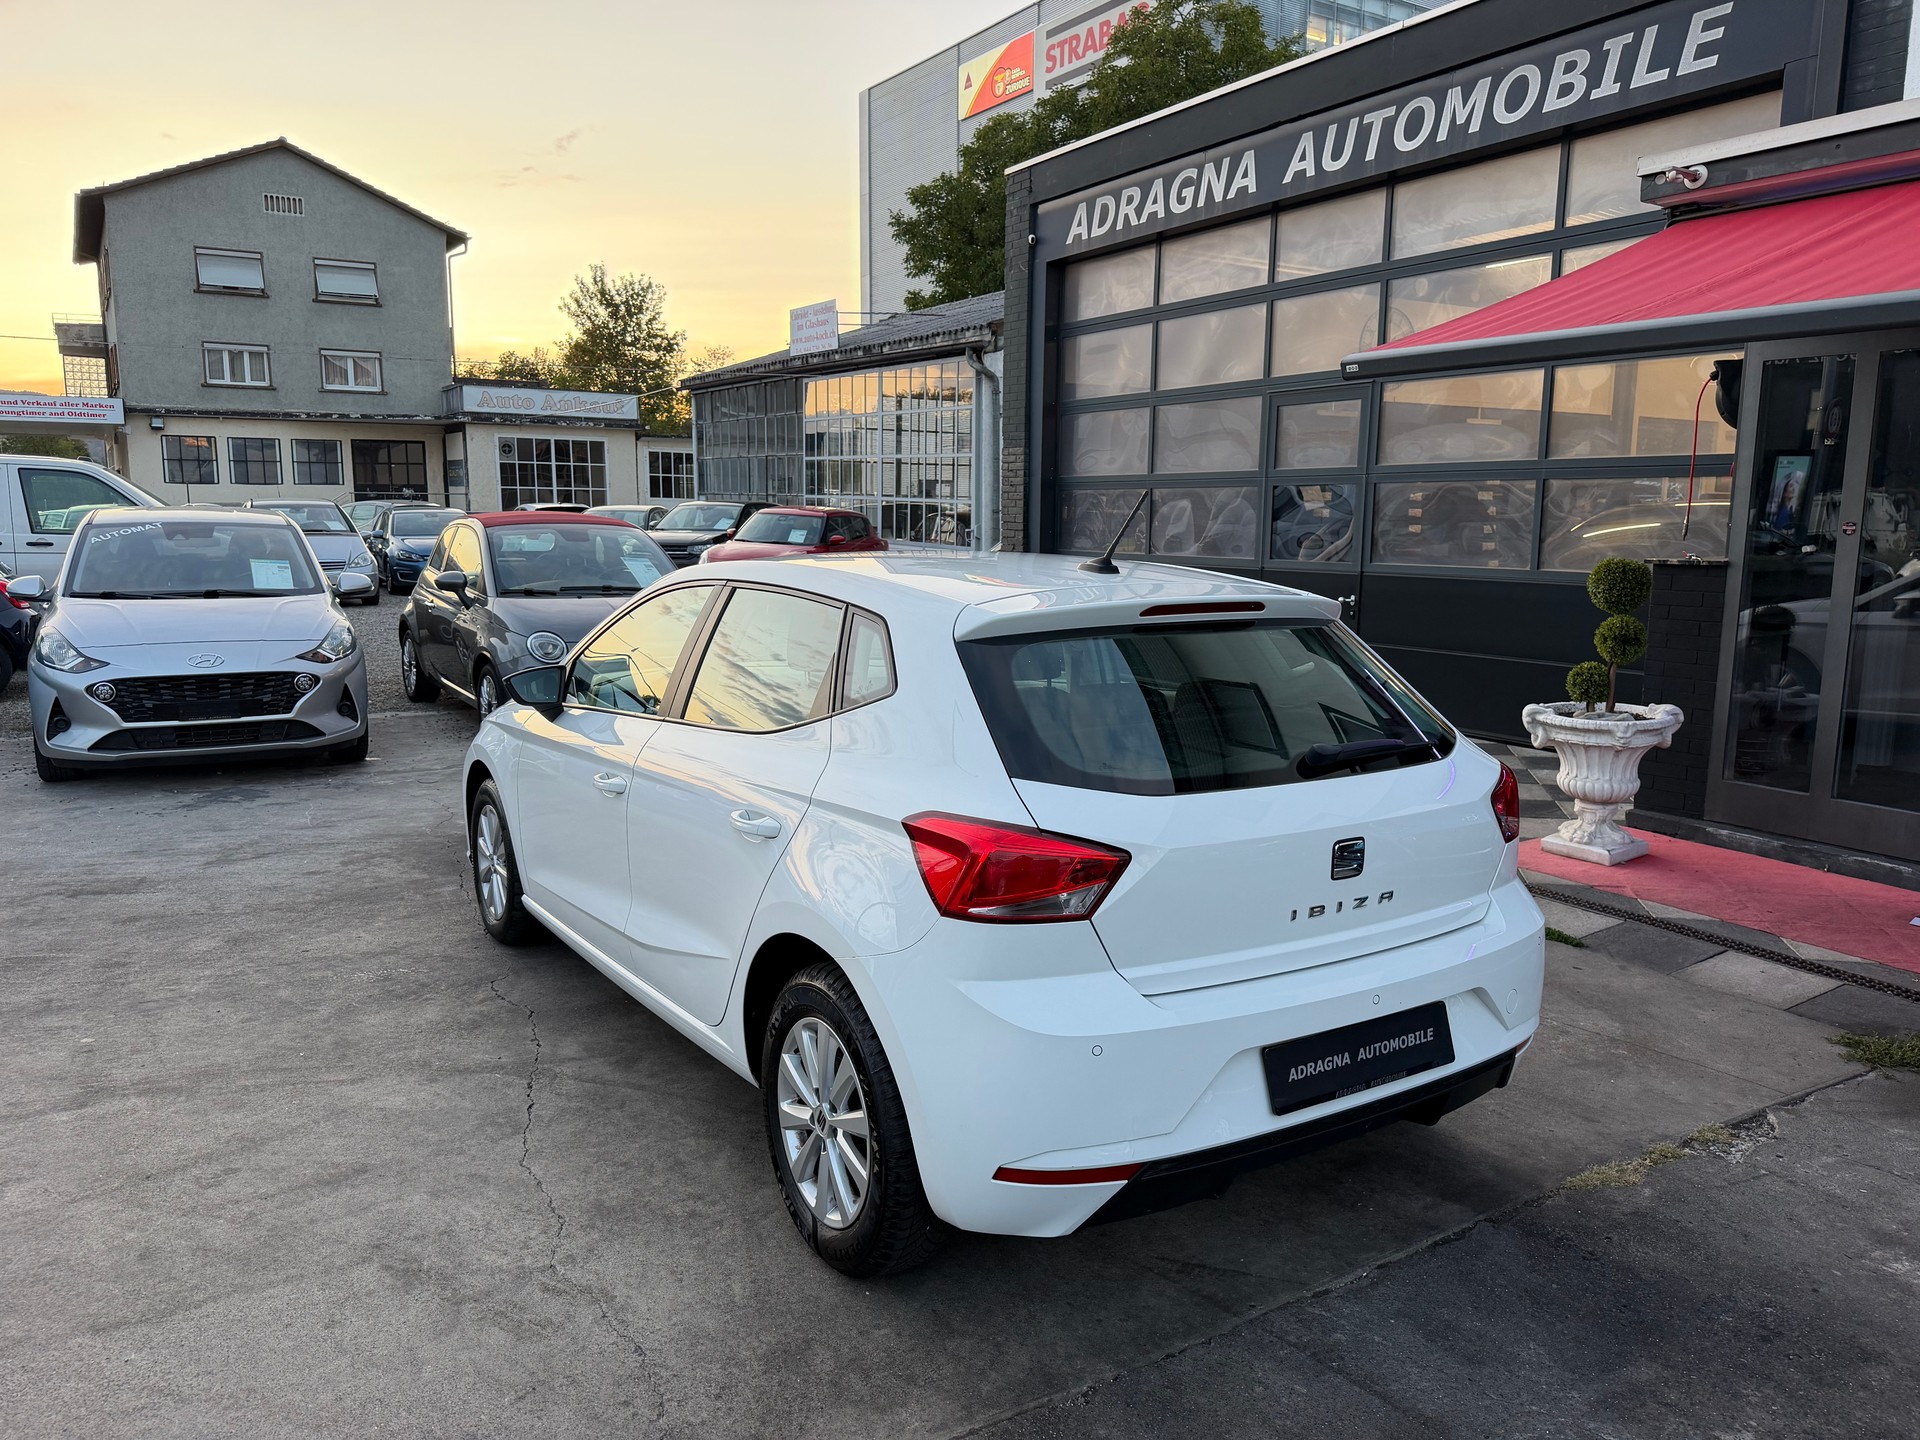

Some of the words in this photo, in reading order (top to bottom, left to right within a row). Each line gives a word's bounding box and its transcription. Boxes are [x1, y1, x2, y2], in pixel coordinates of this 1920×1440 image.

[1066, 149, 1258, 245] ADRAGNA
[1282, 2, 1734, 184] AUTOMOBILE
[477, 390, 535, 410] Auto
[541, 394, 625, 415] Ankauf
[91, 521, 163, 544] AUTOMAT
[1290, 890, 1394, 921] IBIZA
[1288, 1052, 1351, 1082] ADRAGNA
[1357, 1027, 1434, 1062] AUTOMOBILE
